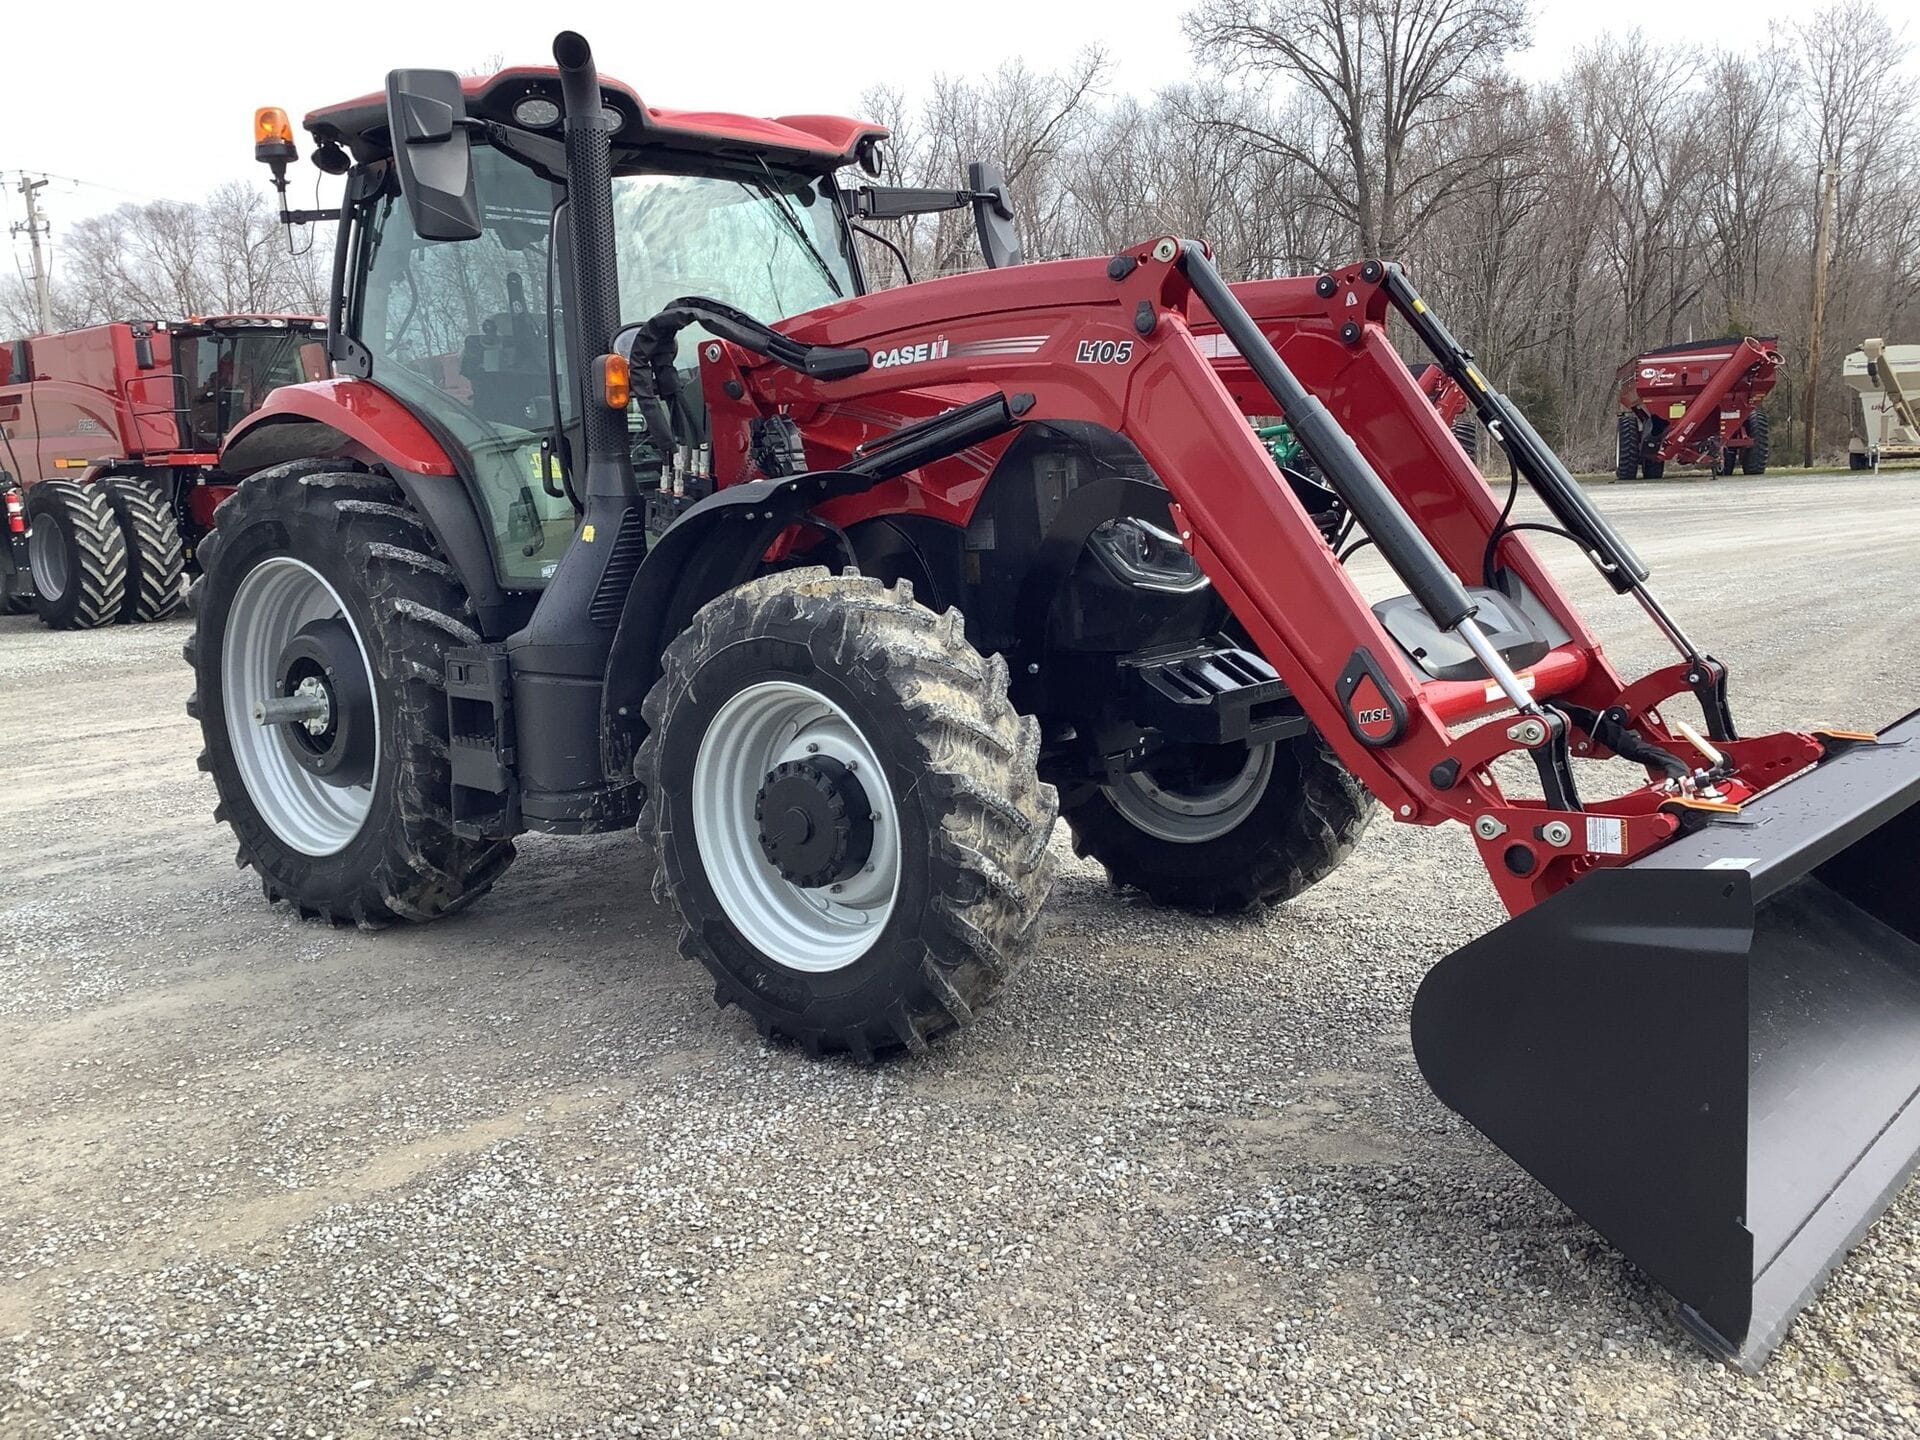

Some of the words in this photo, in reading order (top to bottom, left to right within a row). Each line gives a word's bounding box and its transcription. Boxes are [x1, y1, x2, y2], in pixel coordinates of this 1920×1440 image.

[872, 343, 928, 369] CASE
[1075, 340, 1134, 365] L105
[1358, 707, 1392, 725] MSL
